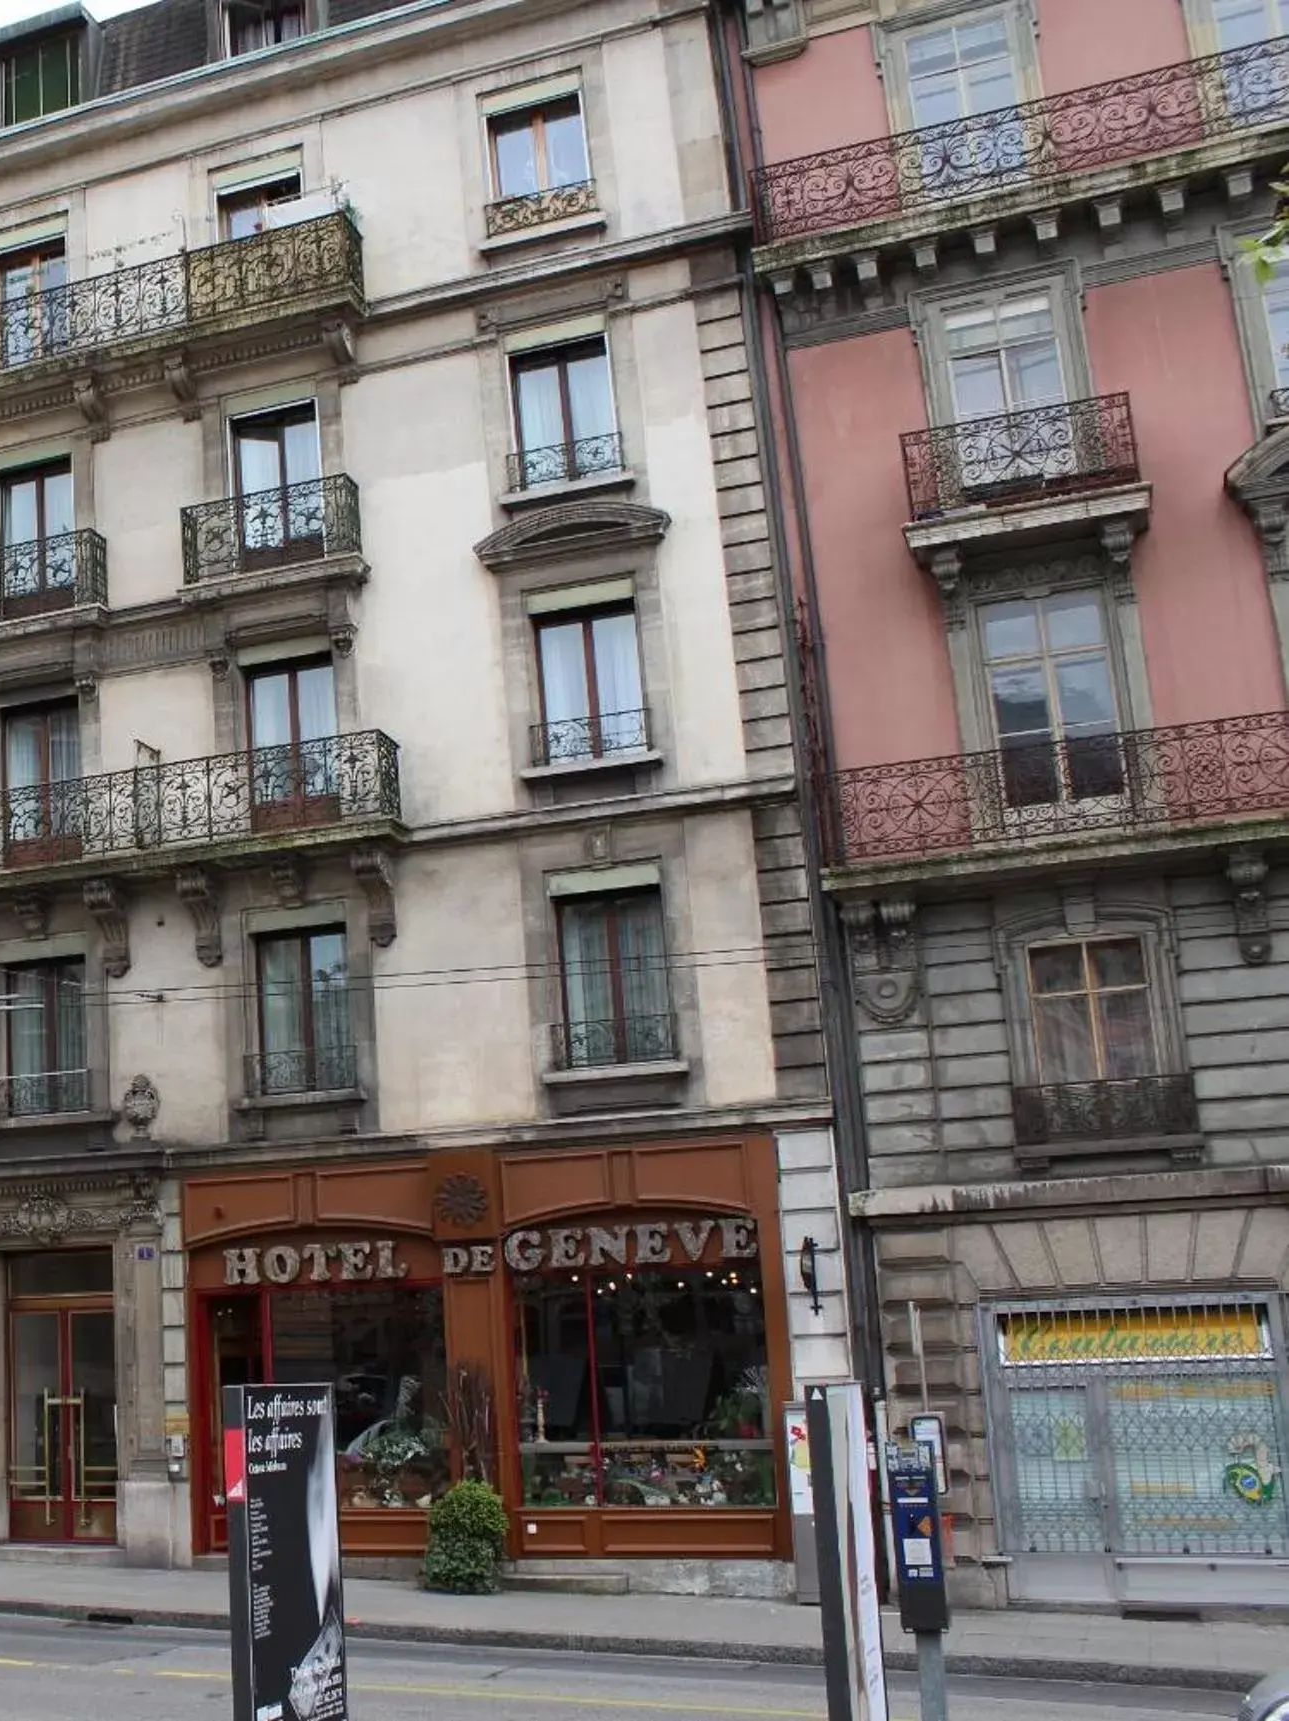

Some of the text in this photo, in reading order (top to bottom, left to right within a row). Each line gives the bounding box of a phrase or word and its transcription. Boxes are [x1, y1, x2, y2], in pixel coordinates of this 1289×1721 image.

[223, 1217, 758, 1286] HOTEL DE GENEVE
[247, 1395, 266, 1419] Les
[267, 1393, 305, 1426] affaires
[248, 1426, 303, 1459] les affaires
